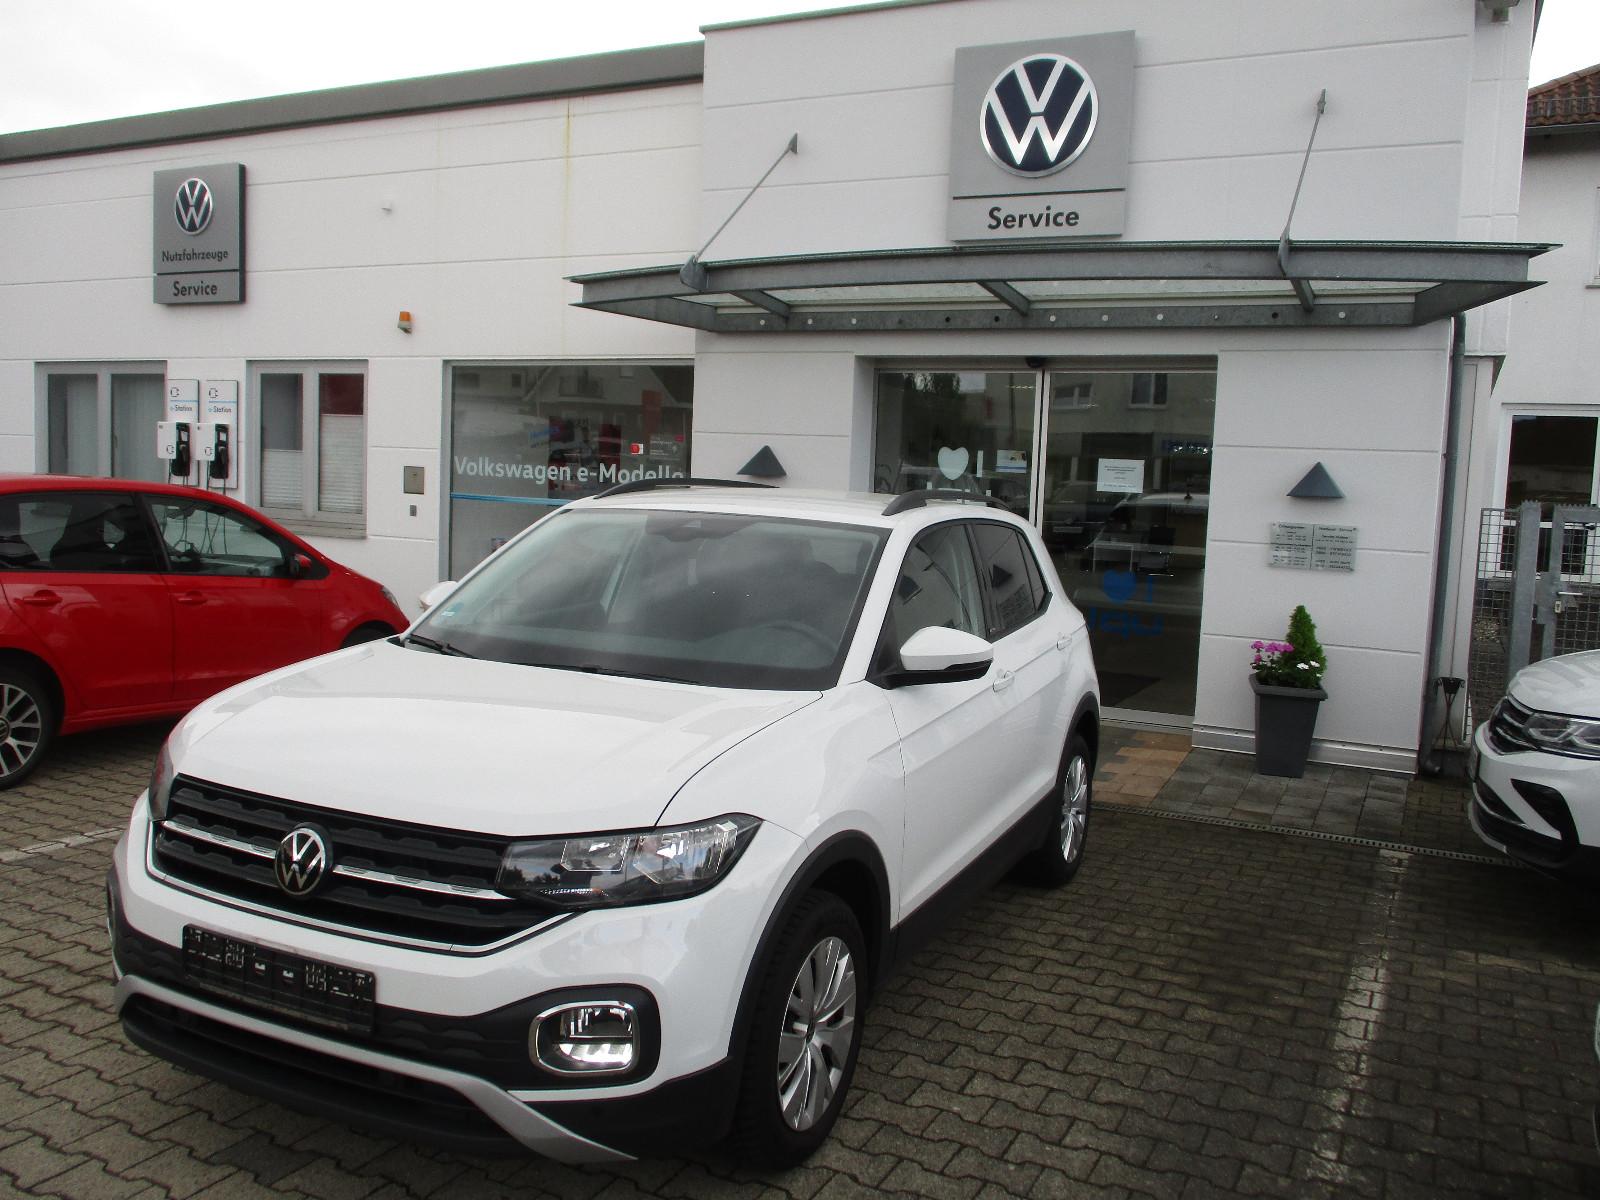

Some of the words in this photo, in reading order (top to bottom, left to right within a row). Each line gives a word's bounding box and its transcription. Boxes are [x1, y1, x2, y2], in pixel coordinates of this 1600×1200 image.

[982, 55, 1096, 172] VW
[988, 205, 1079, 230] Service
[161, 248, 229, 262] Nutzfahrzeuge
[173, 280, 218, 296] Service
[453, 456, 571, 485] Volkswagen
